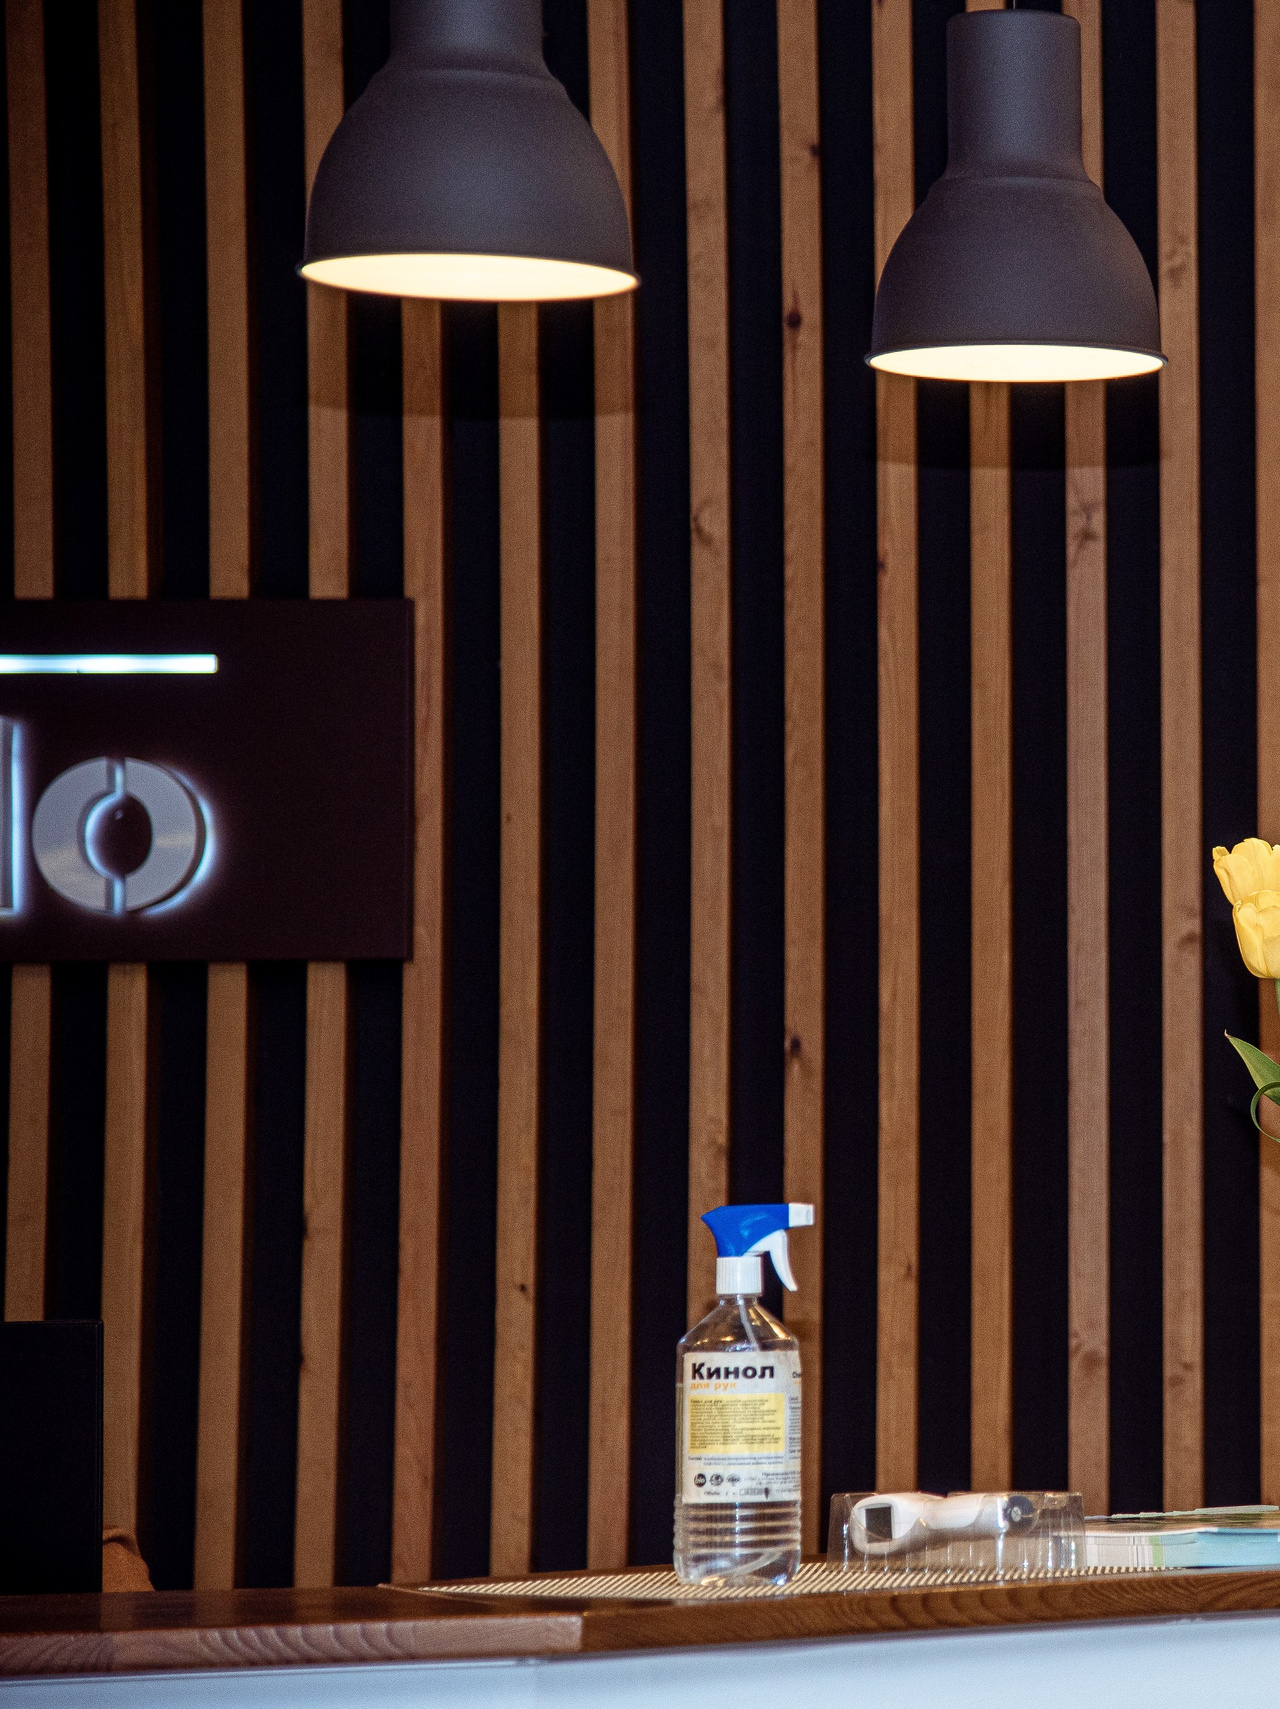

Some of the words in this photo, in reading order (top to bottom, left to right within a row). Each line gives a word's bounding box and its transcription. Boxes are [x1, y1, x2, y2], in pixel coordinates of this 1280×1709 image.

[691, 1362, 775, 1380] Кинол
[690, 1382, 710, 1390] для
[714, 1381, 738, 1391] рук
